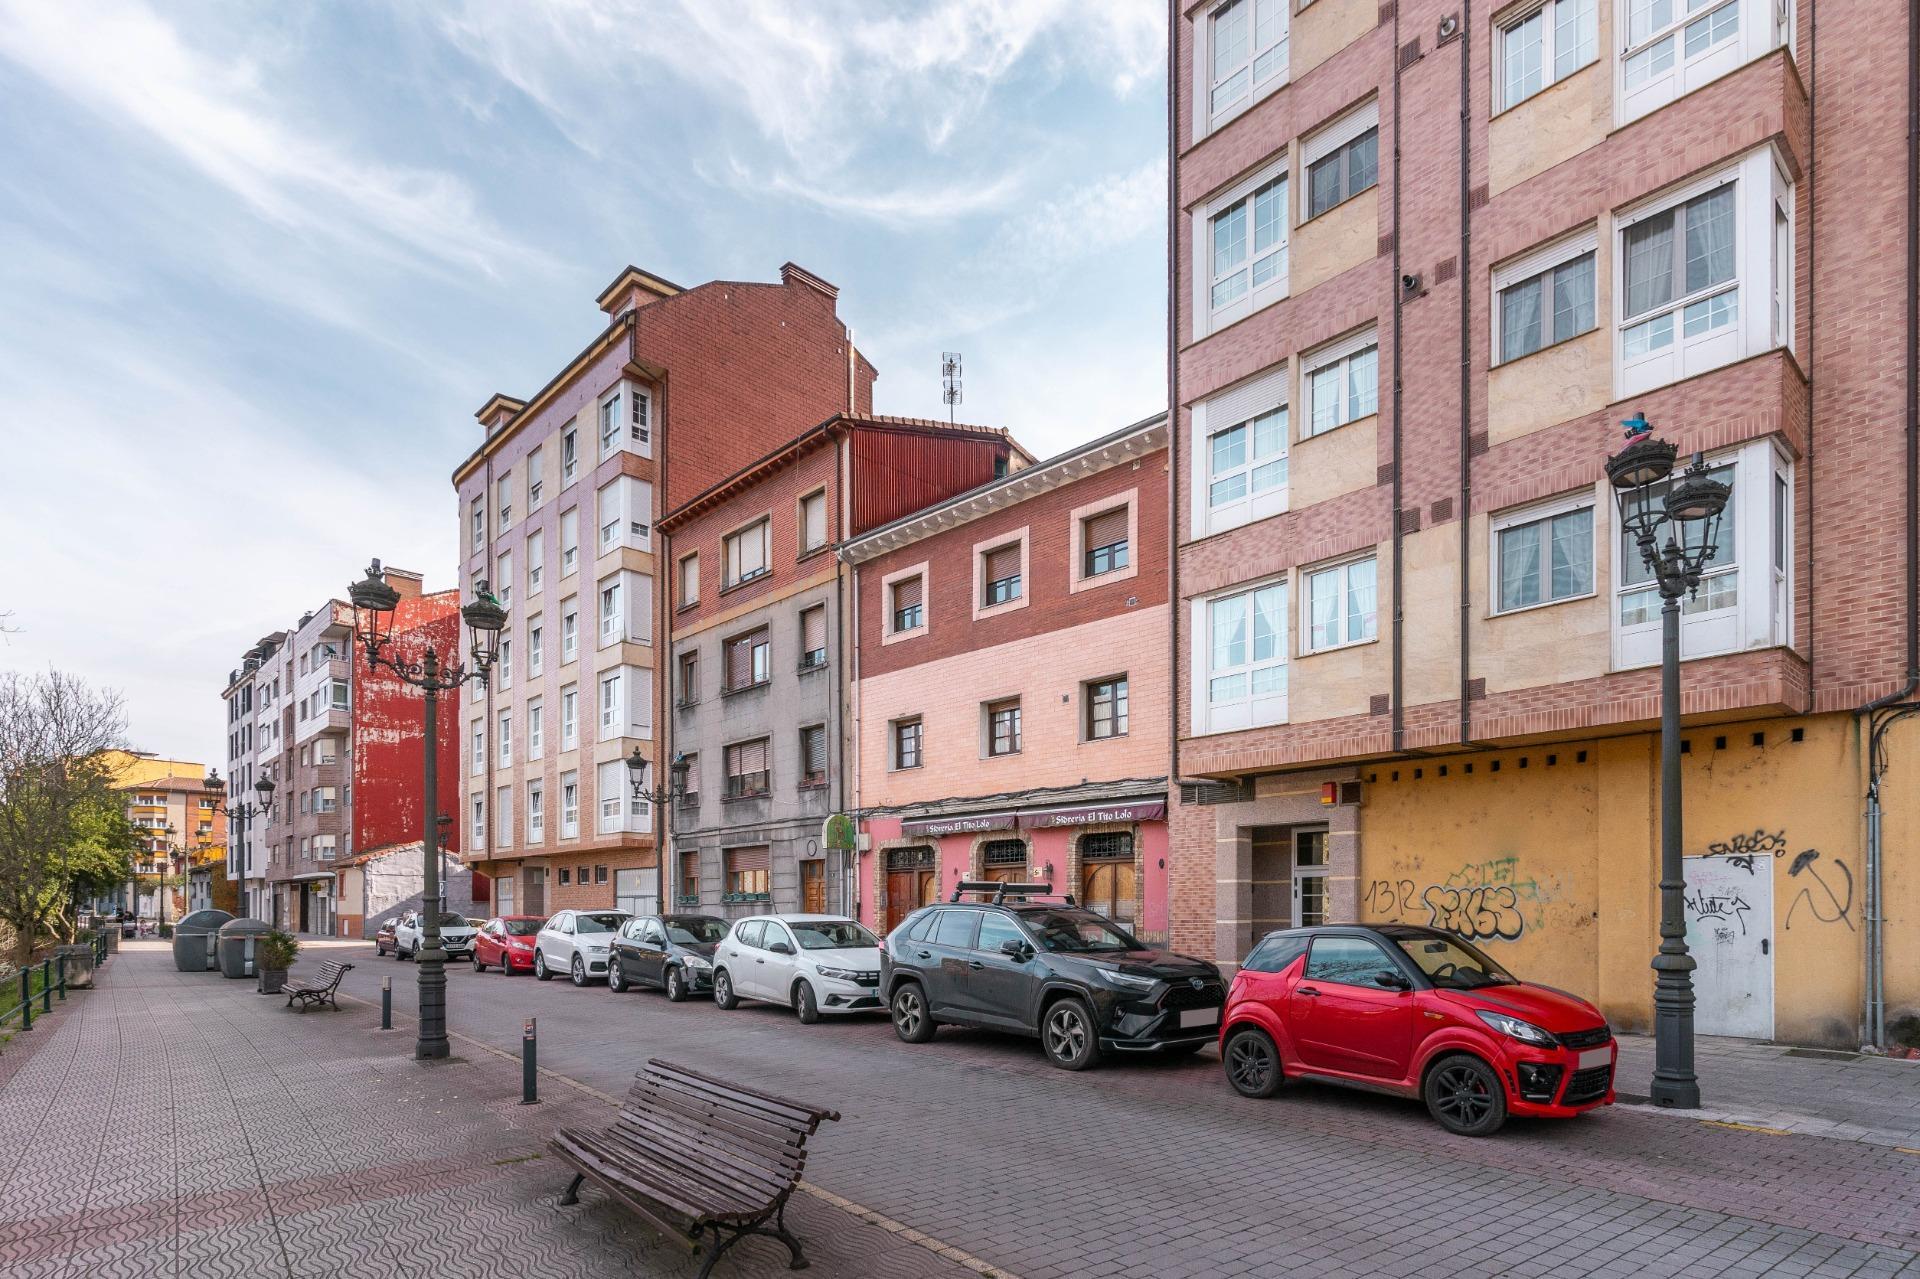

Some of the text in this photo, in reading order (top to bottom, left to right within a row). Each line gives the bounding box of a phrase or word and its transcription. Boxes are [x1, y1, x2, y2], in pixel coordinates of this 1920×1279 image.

[1087, 811, 1096, 822] El
[1114, 809, 1132, 820] Lolo
[954, 821, 961, 831] El
[976, 818, 990, 828] Lolo
[1364, 879, 1427, 916] 1312
